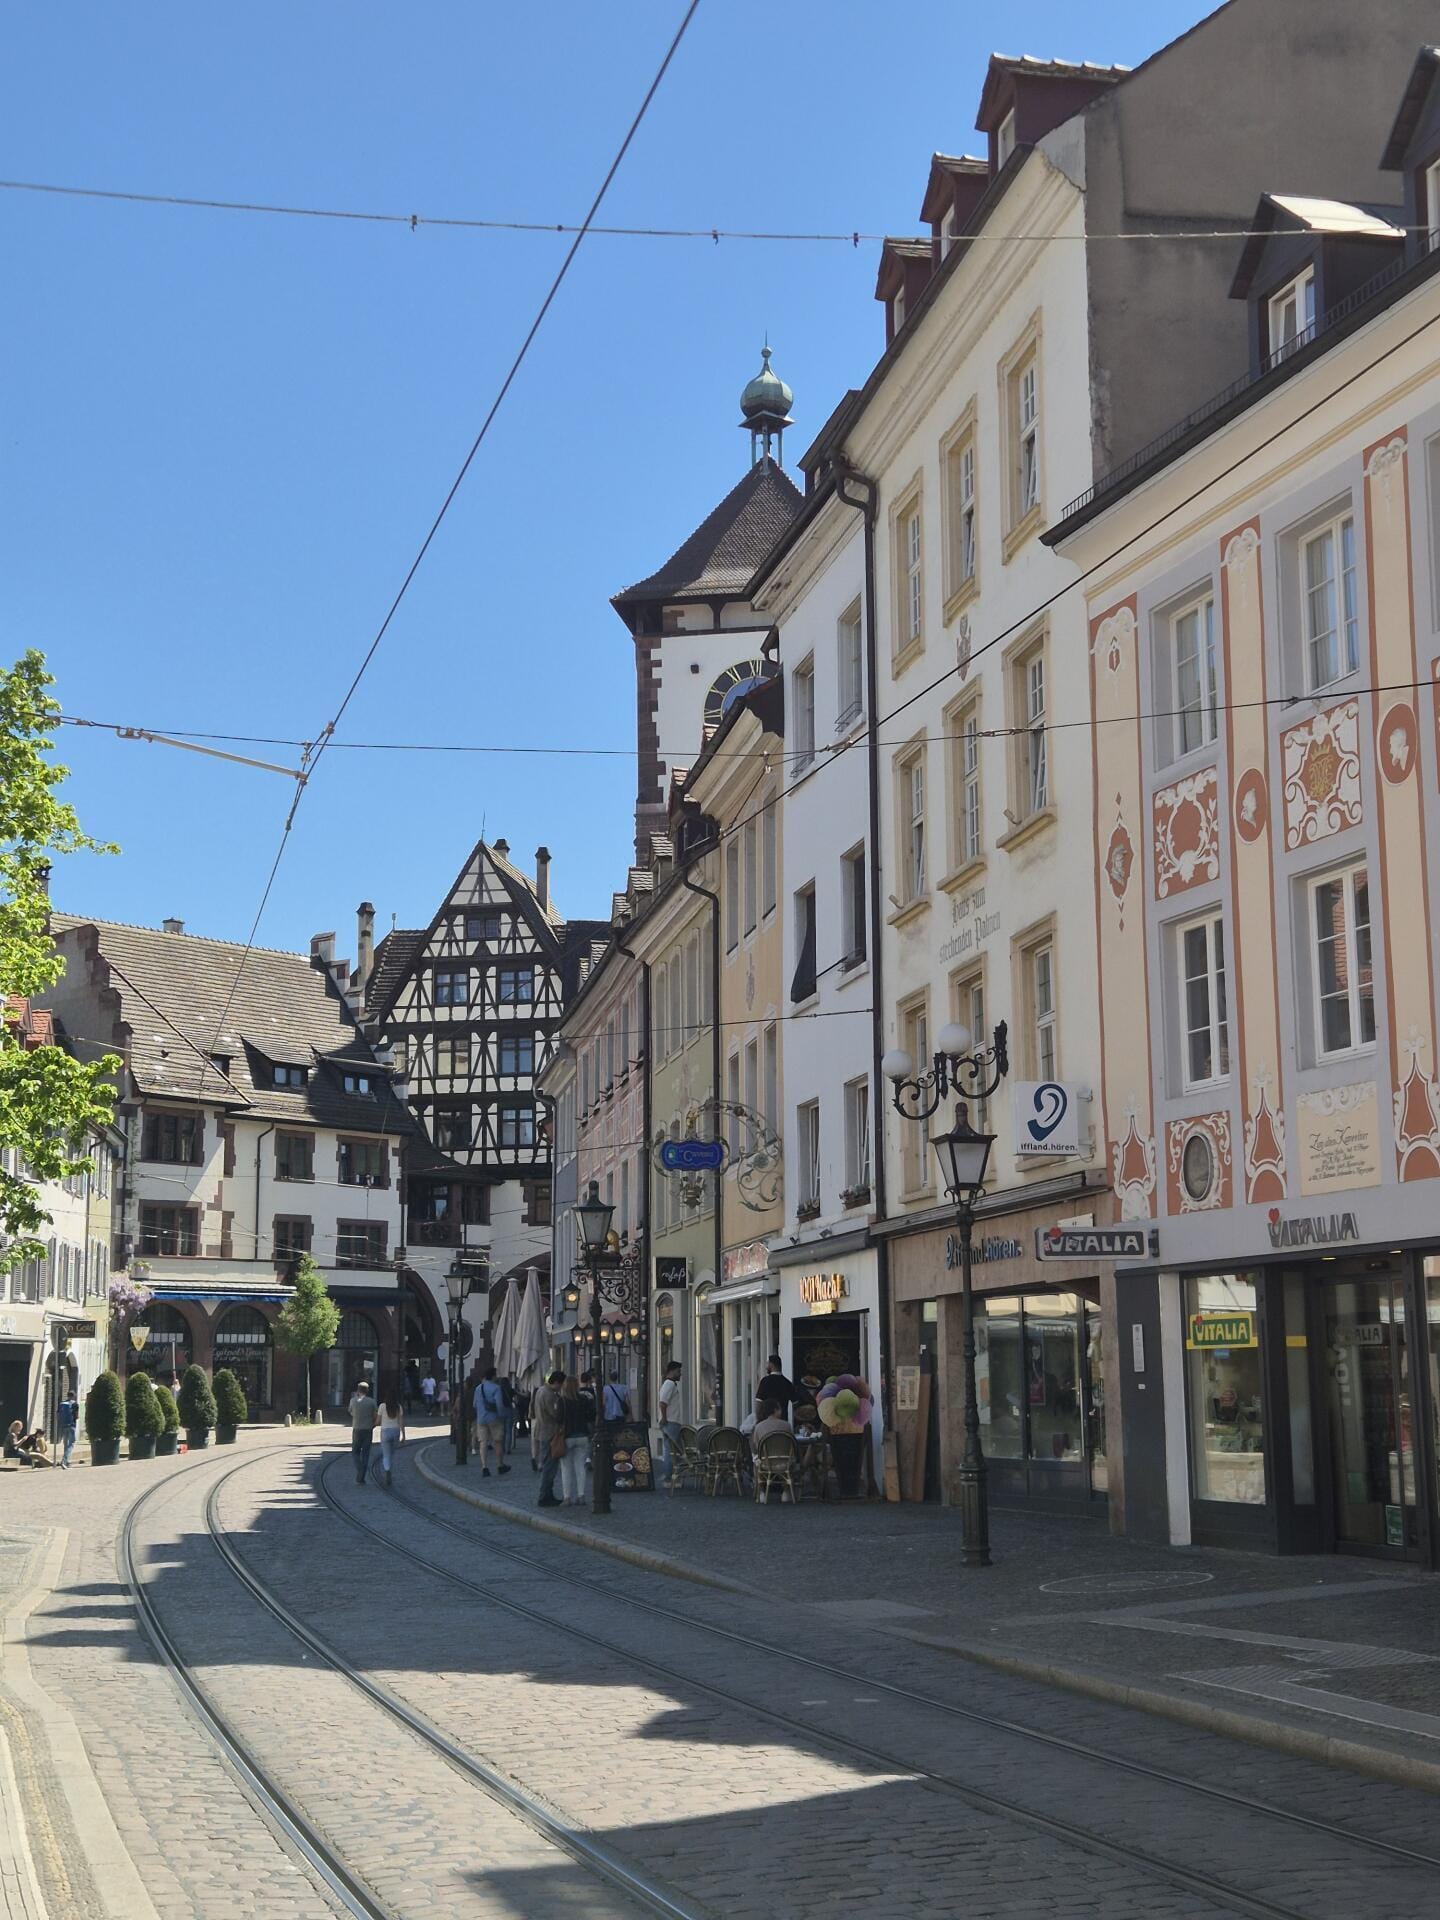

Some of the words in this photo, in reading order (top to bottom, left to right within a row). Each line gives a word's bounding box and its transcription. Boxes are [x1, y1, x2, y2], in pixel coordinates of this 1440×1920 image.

[1020, 1142, 1078, 1152] iffland.hören.
[1268, 1213, 1359, 1247] VITALIA
[1195, 1322, 1248, 1341] VITALIA
